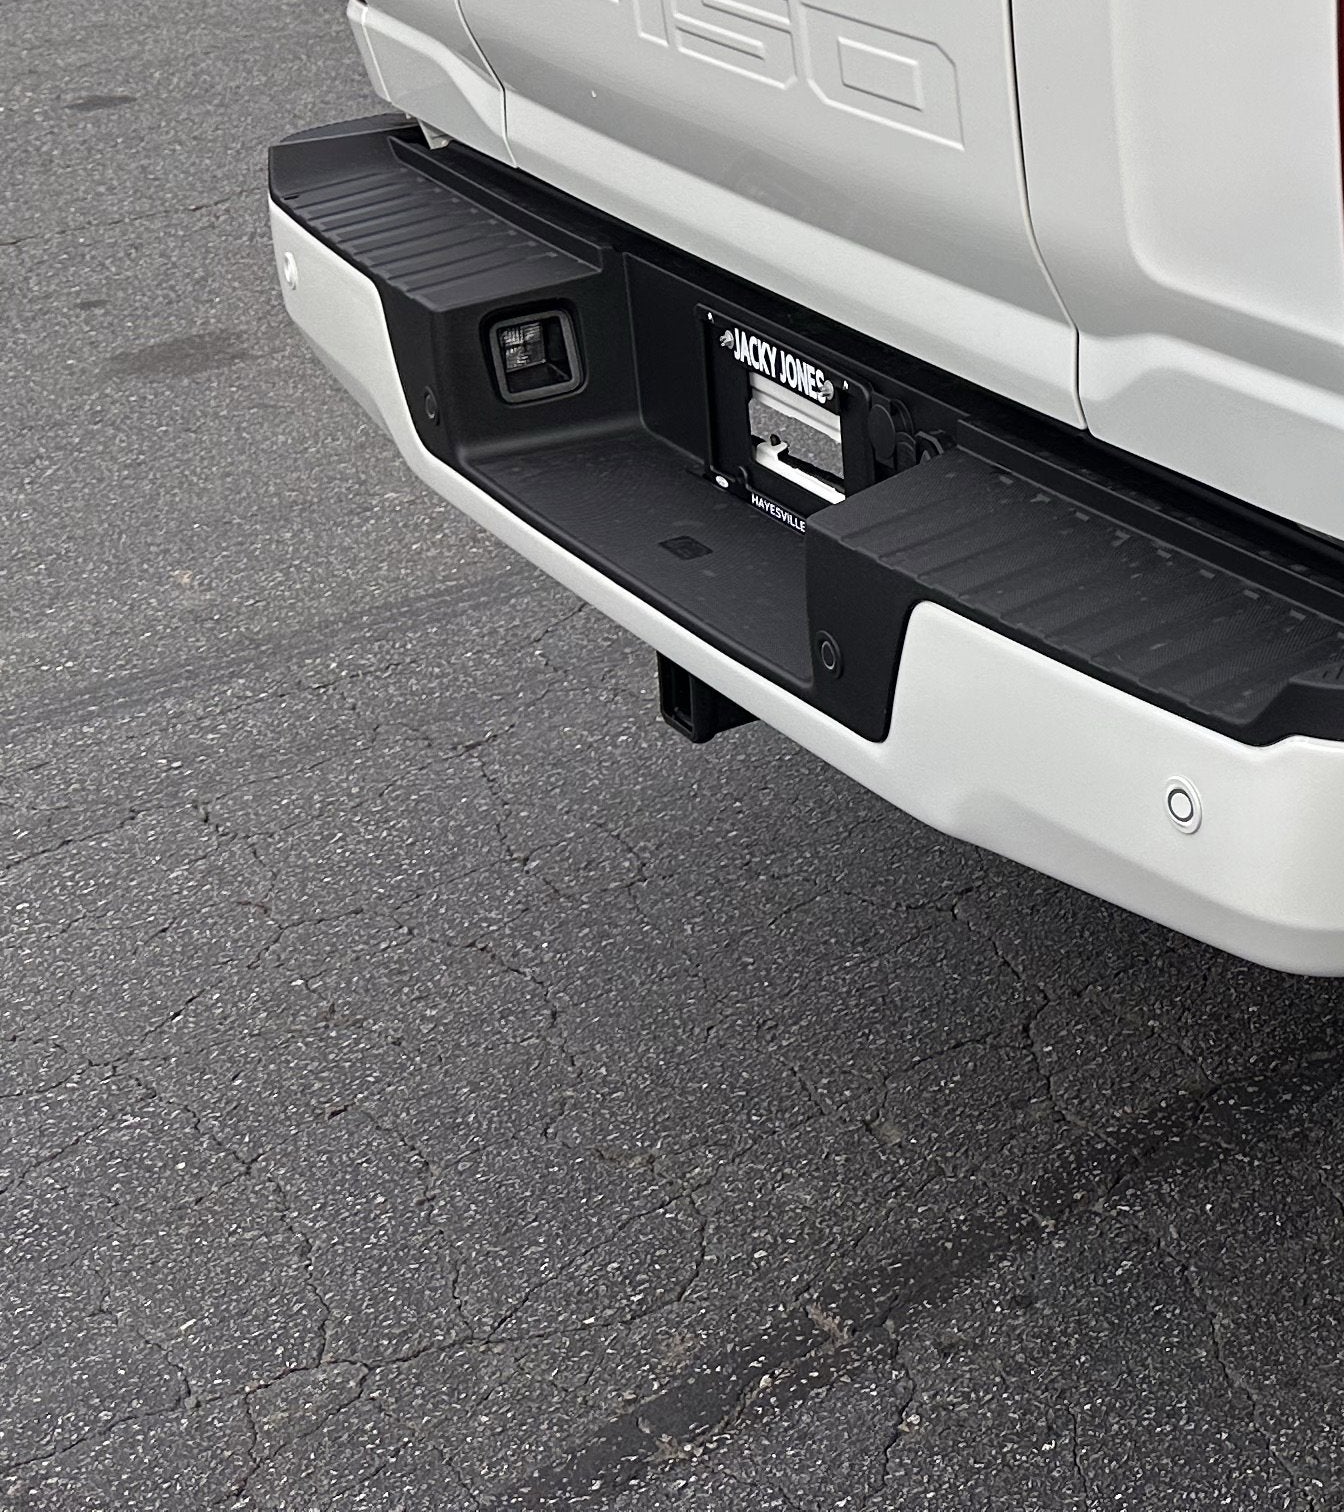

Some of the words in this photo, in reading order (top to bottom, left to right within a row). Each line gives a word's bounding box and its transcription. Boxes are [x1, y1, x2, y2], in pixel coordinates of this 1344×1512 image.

[733, 327, 778, 378] JACKY
[779, 350, 826, 404] JONES
[751, 492, 806, 533] HAYESVILLE
